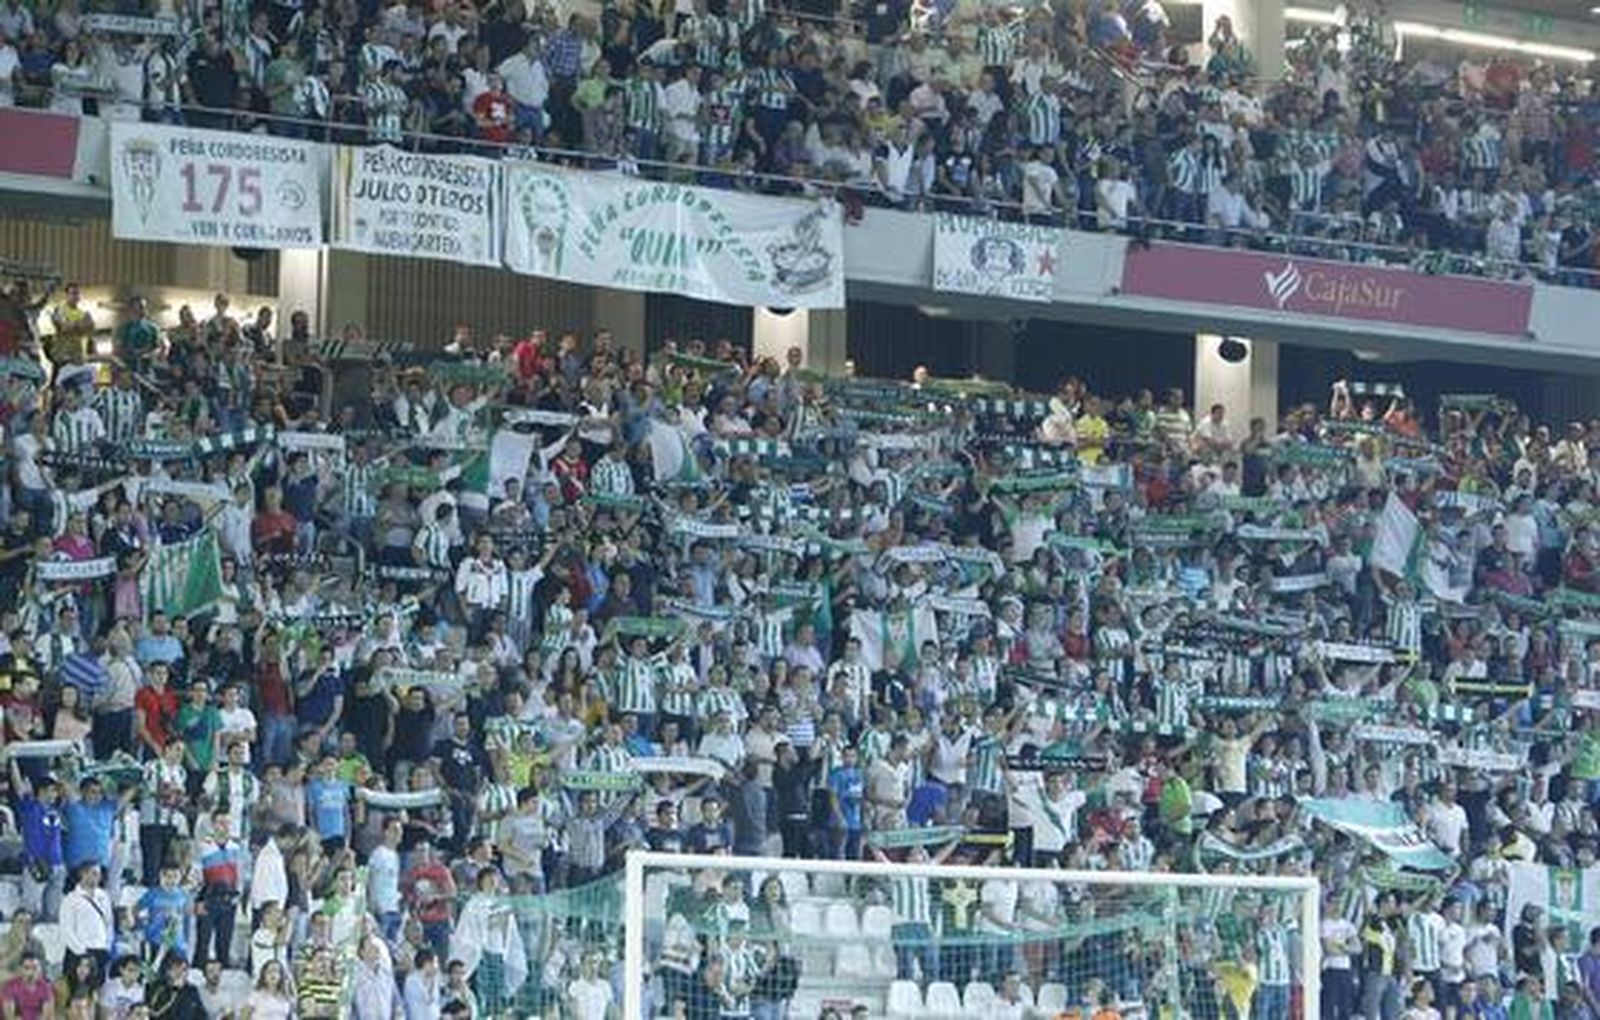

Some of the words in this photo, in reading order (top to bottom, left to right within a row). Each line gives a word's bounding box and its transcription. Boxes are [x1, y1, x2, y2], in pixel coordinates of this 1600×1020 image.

[179, 161, 263, 216] 175
[354, 178, 411, 204] JULIO
[1304, 270, 1405, 315] CajaSur
